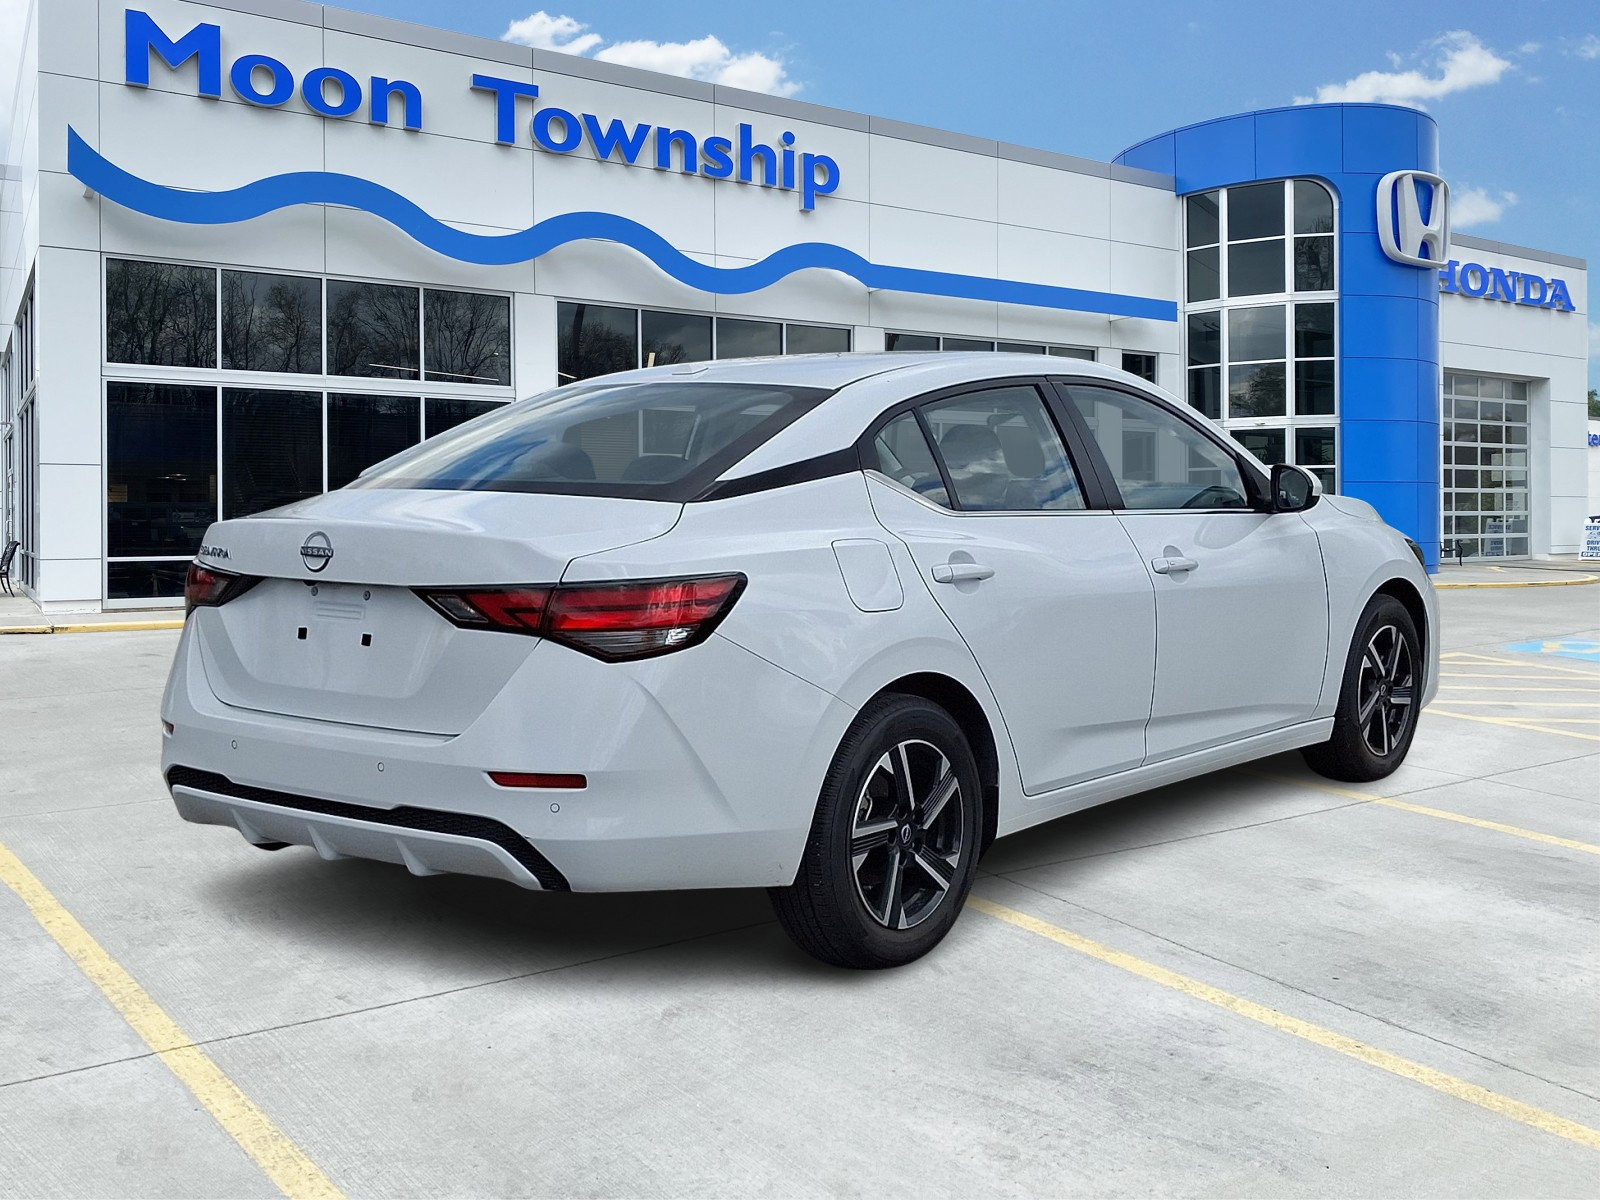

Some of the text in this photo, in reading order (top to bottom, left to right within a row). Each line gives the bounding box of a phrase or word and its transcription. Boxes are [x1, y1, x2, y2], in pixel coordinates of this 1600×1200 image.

[125, 9, 841, 211] Moon Township
[1438, 259, 1576, 312] HONDA
[301, 547, 333, 557] NISSAN
